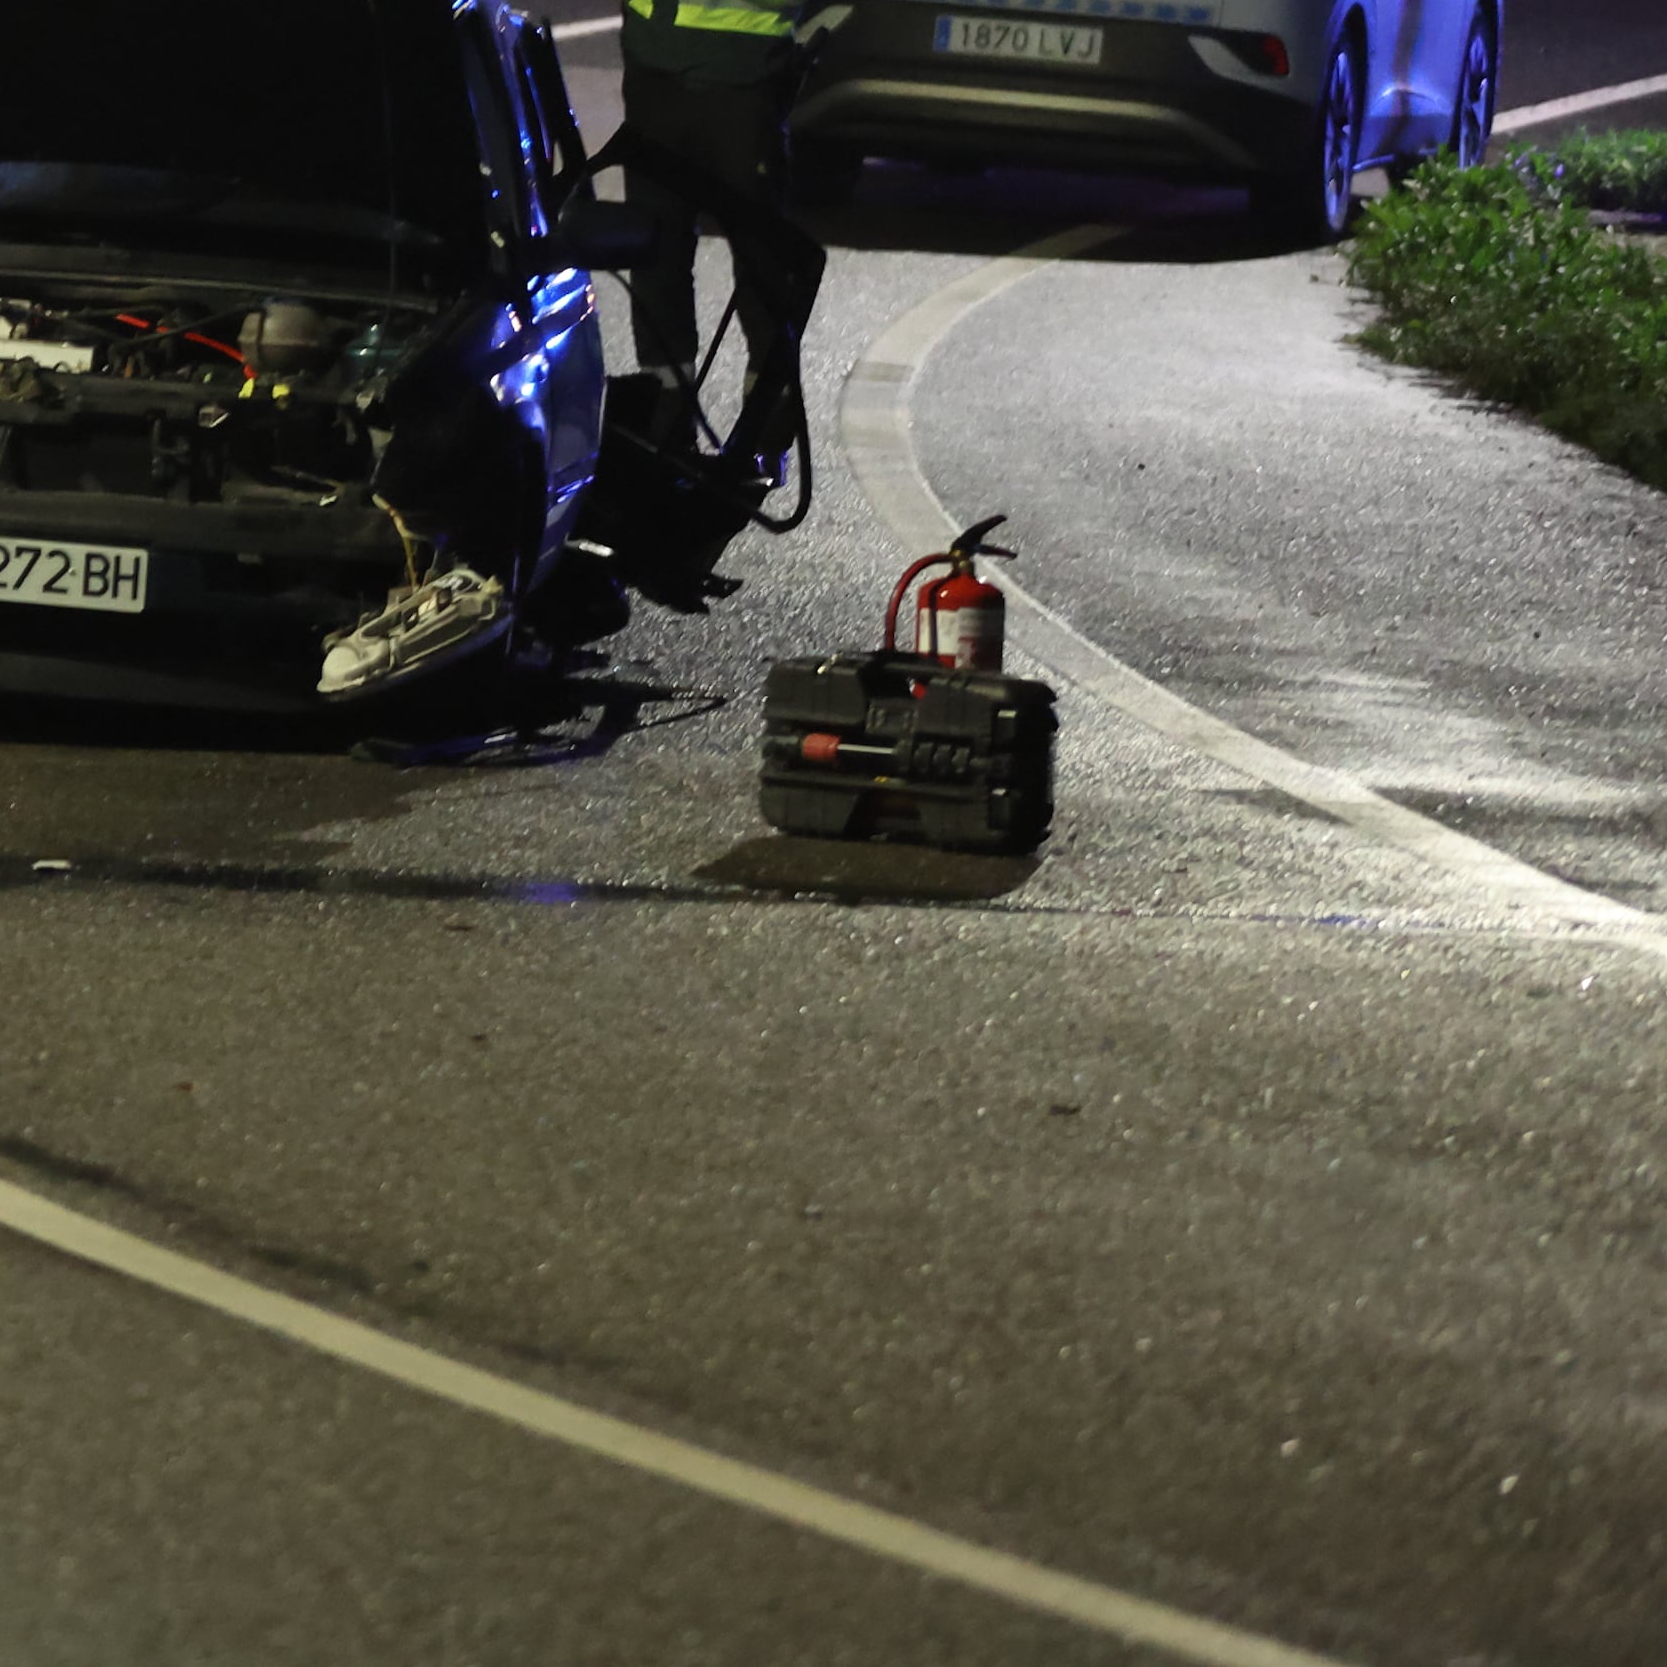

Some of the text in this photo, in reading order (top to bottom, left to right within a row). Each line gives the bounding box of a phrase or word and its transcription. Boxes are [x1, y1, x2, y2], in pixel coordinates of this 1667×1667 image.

[960, 21, 1097, 59] 1870 LVJ
[82, 552, 141, 601] BH
